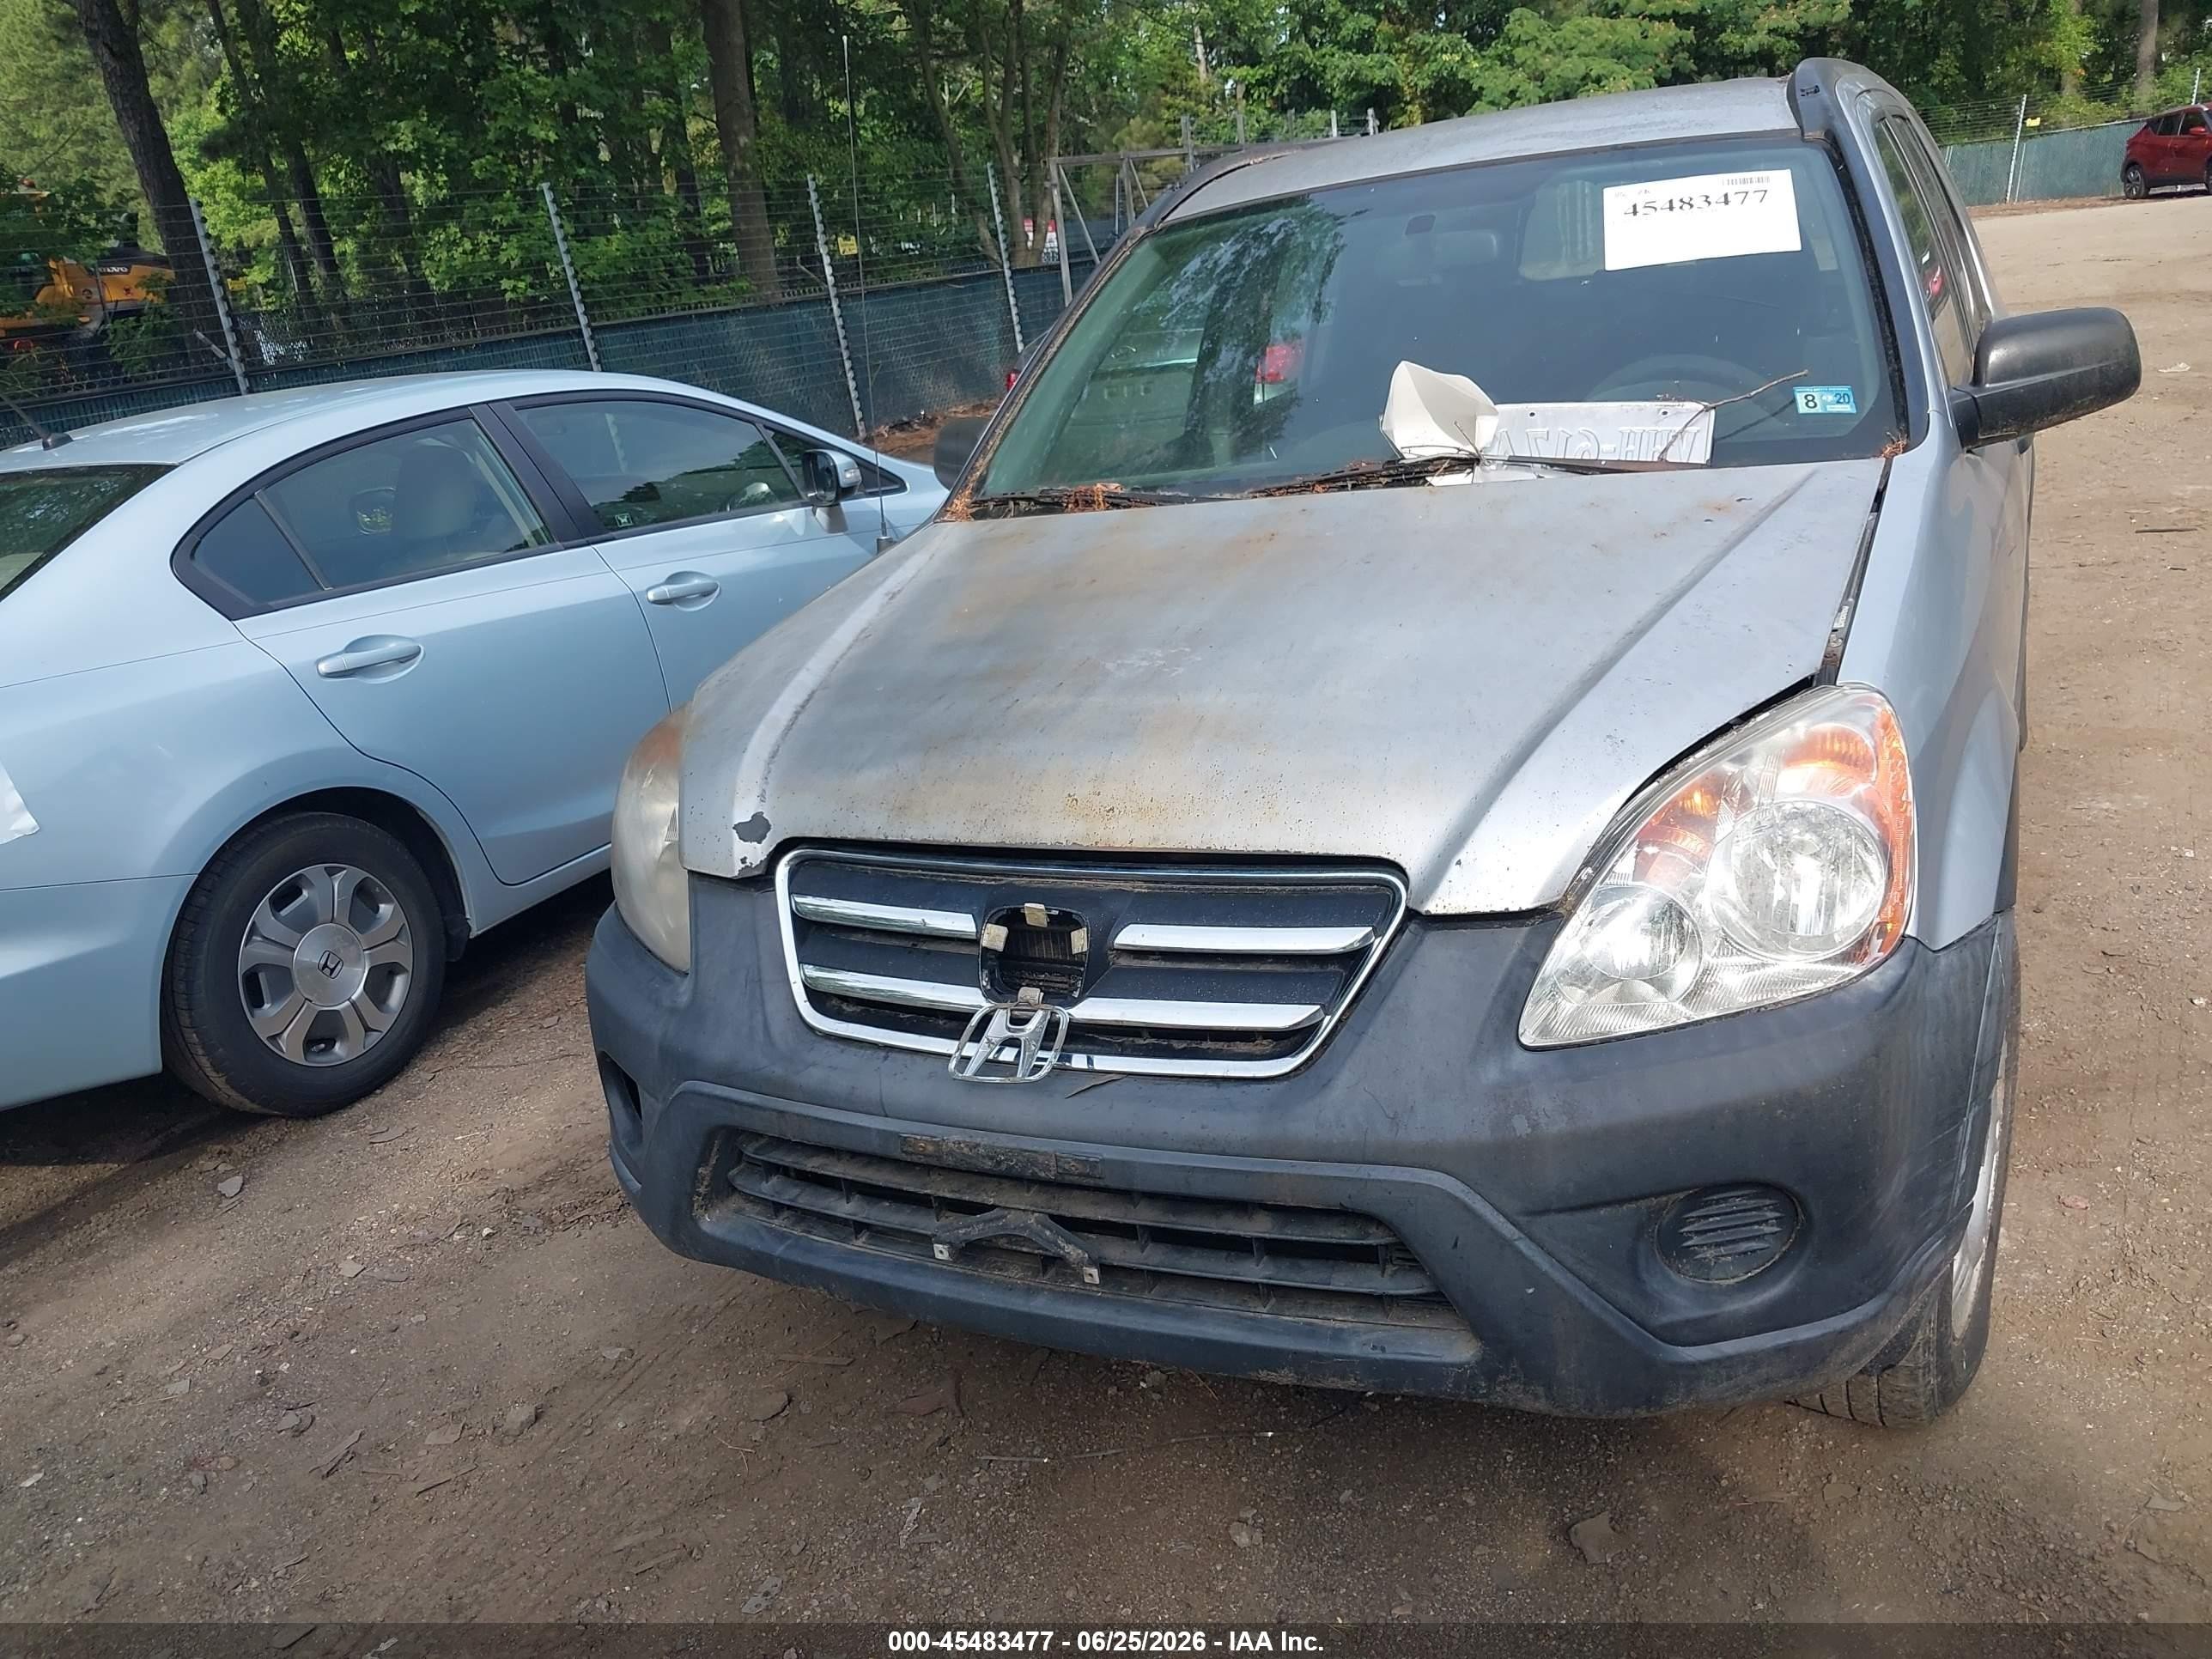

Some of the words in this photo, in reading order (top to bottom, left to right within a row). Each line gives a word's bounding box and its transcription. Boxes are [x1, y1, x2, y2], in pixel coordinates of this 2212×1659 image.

[1624, 189, 1768, 216] 45483477
[1804, 393, 1818, 409] 8
[1834, 393, 1850, 404] 20
